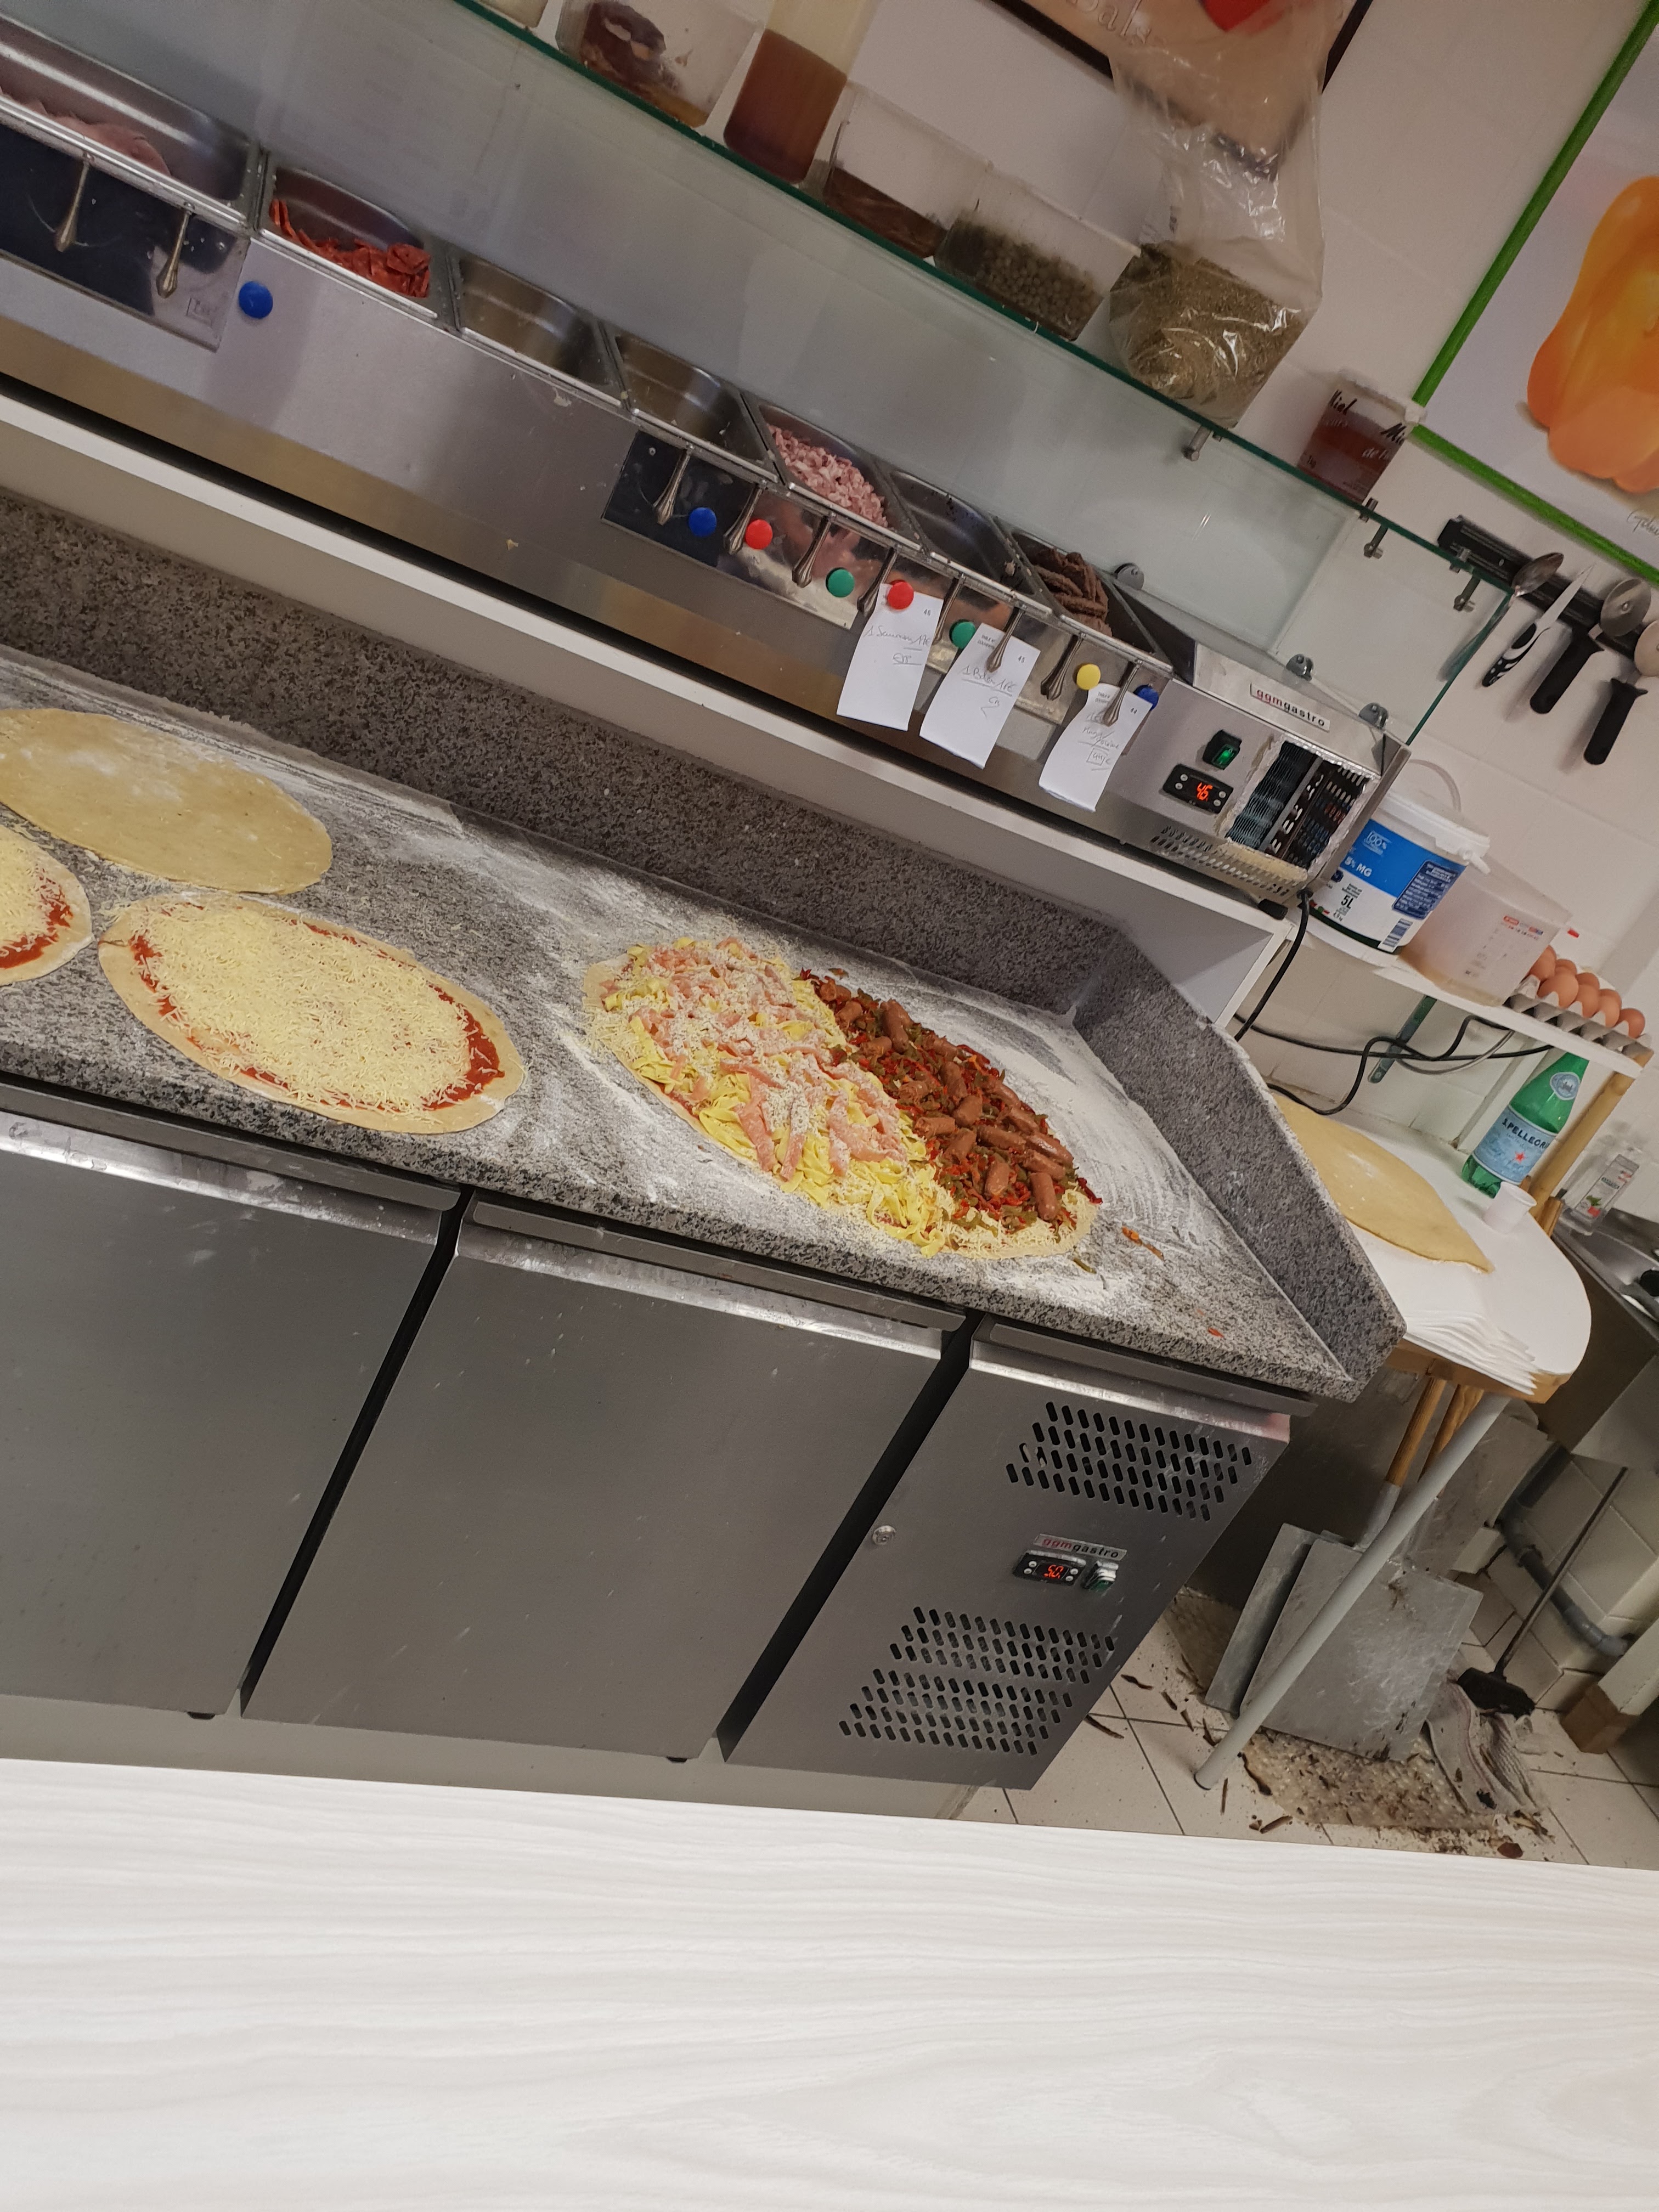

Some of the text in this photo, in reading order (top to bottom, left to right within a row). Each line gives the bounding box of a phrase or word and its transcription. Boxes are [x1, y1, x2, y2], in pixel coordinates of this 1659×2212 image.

[1257, 689, 1325, 727] ggmgastro
[1356, 863, 1372, 877] MG
[1341, 894, 1354, 909] 5L
[1043, 1538, 1119, 1558] ggmgastro
